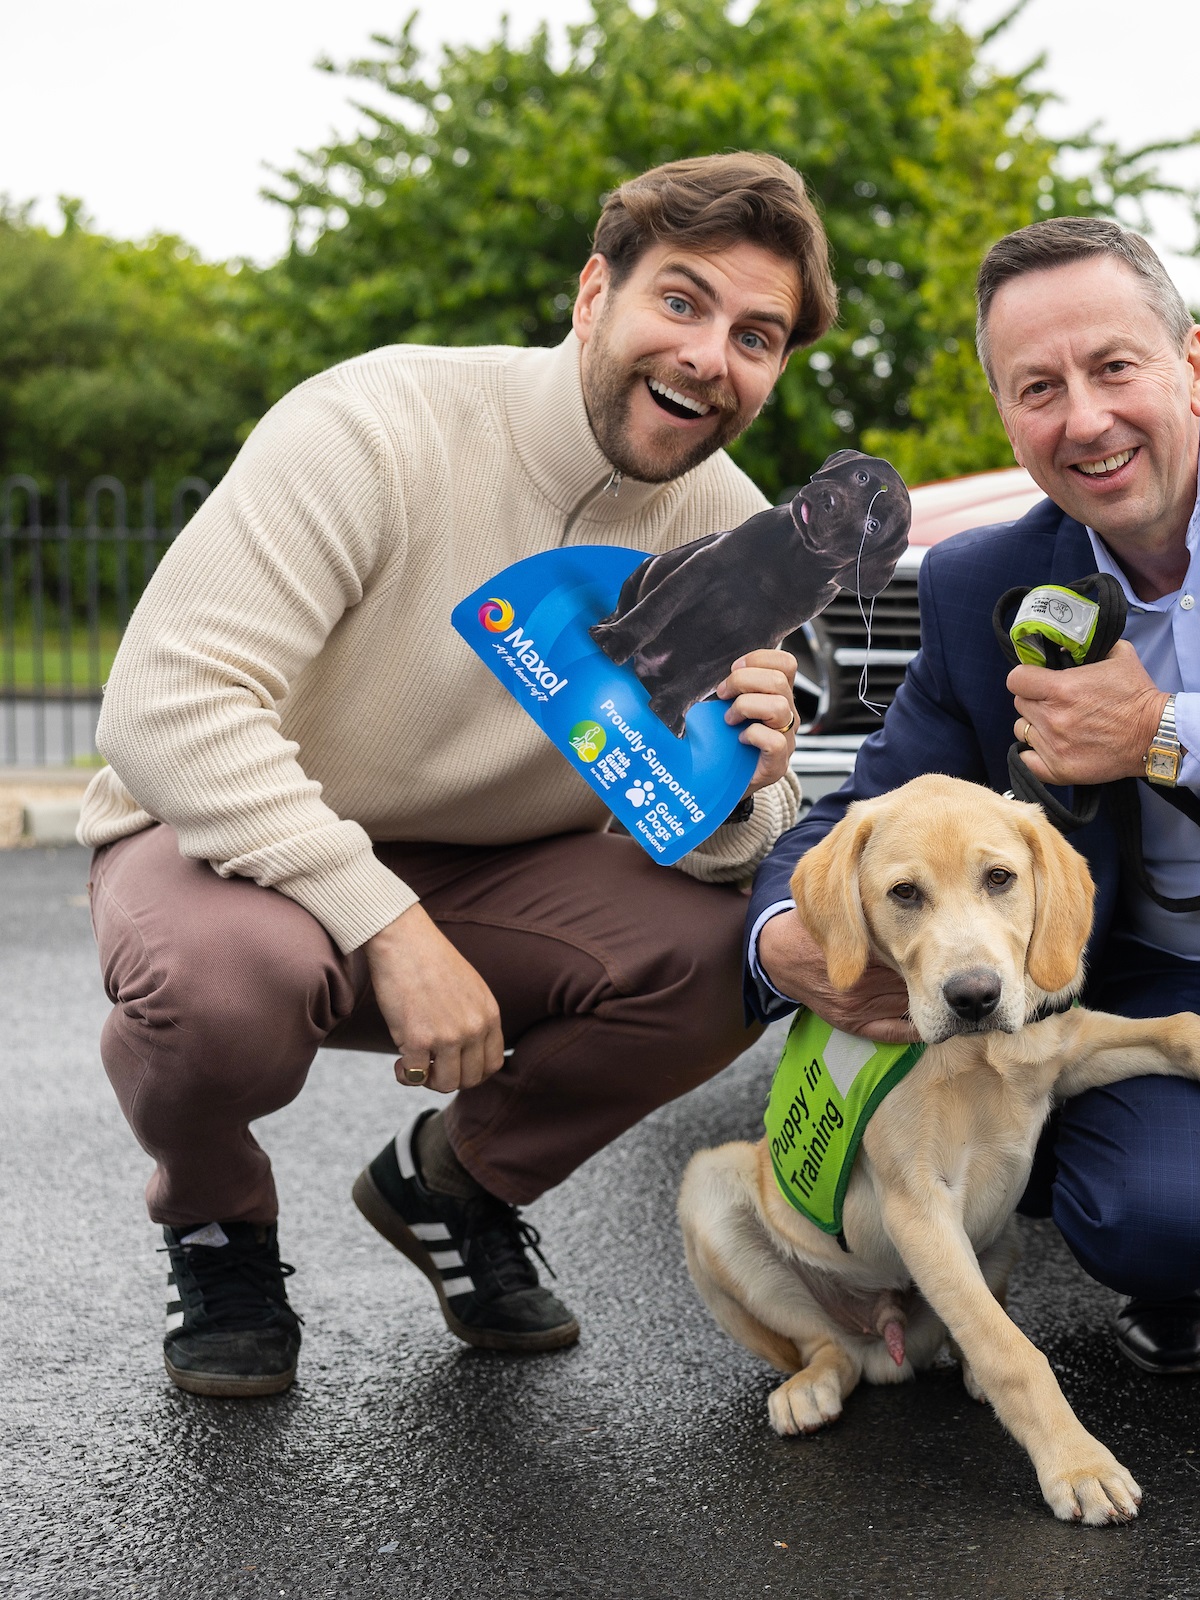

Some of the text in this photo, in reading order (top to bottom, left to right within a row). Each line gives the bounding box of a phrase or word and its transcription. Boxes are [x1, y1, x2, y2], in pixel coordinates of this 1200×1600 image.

[501, 655, 516, 667] the
[514, 667, 536, 687] heart
[530, 687, 545, 697] of
[504, 627, 568, 696] Maxol
[597, 759, 618, 782] Dogs
[600, 699, 706, 823] Proudly Supporting
[605, 754, 627, 779] Guide
[612, 747, 631, 769] Irish
[645, 810, 672, 841] Dogs
[656, 802, 685, 837] Guide
[771, 1058, 822, 1168] Puppy in
[790, 1097, 844, 1199] Training
